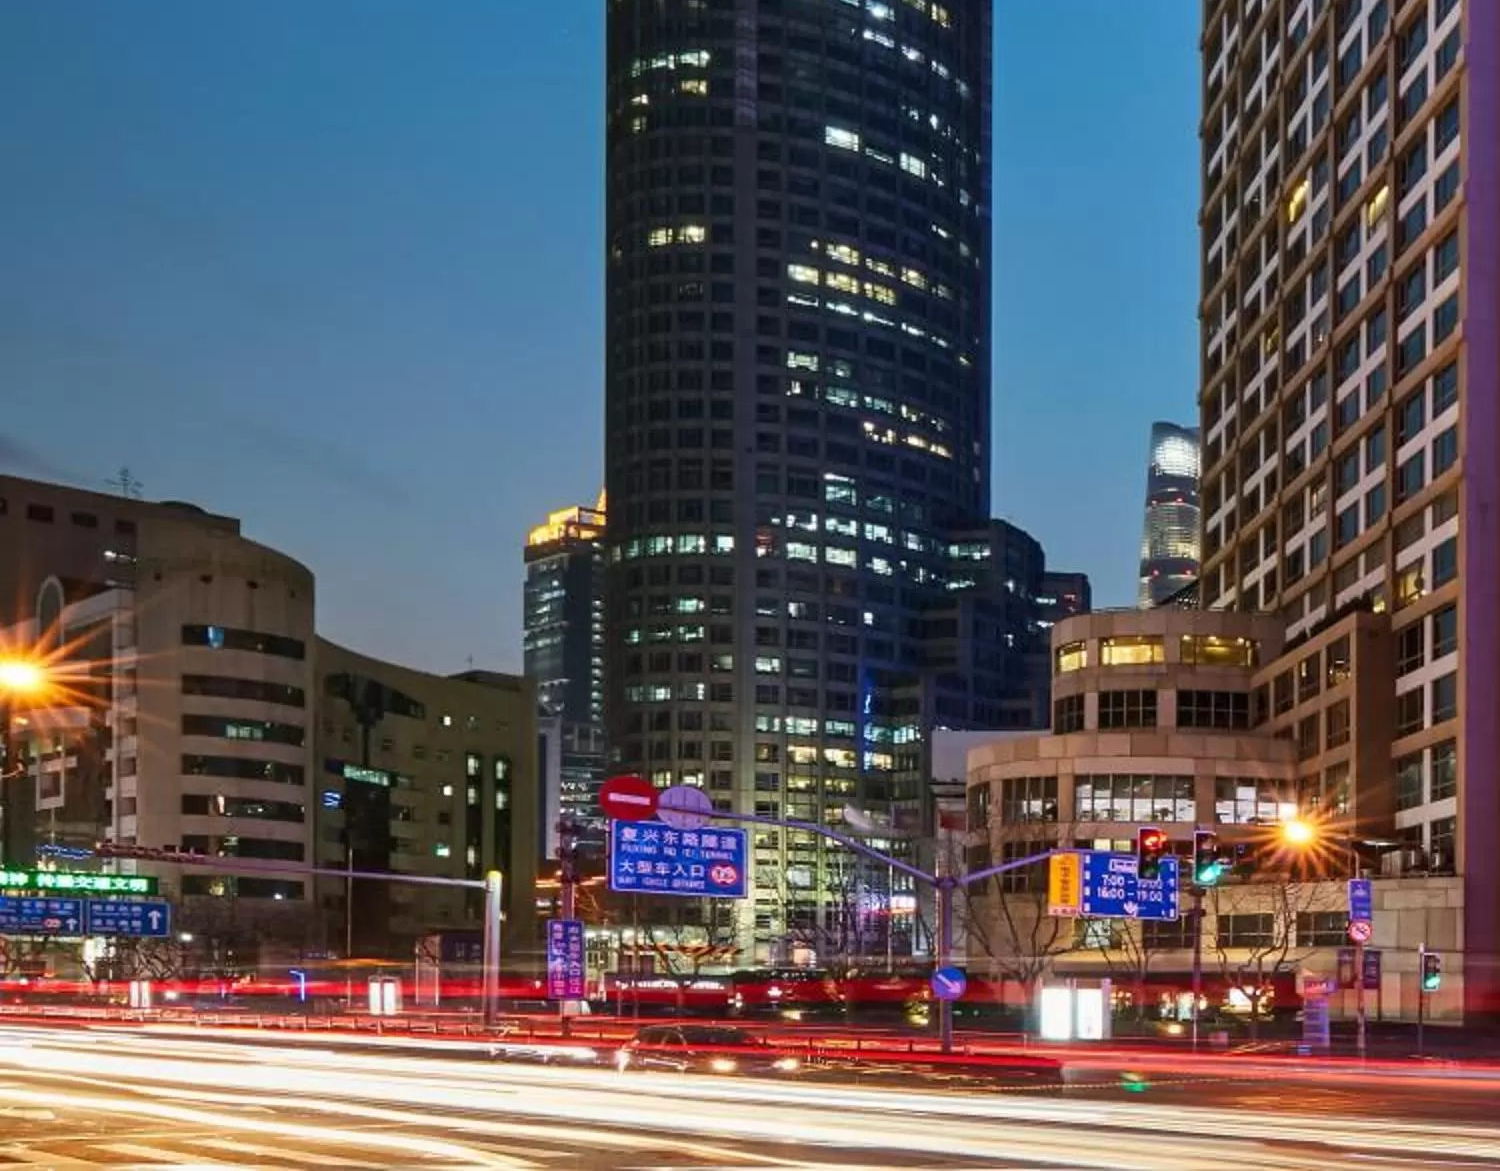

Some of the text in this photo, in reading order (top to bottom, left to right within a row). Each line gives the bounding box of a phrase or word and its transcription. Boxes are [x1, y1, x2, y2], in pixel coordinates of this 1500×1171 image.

[619, 859, 705, 878] 大型车入口
[1101, 874, 1125, 887] 7:00
